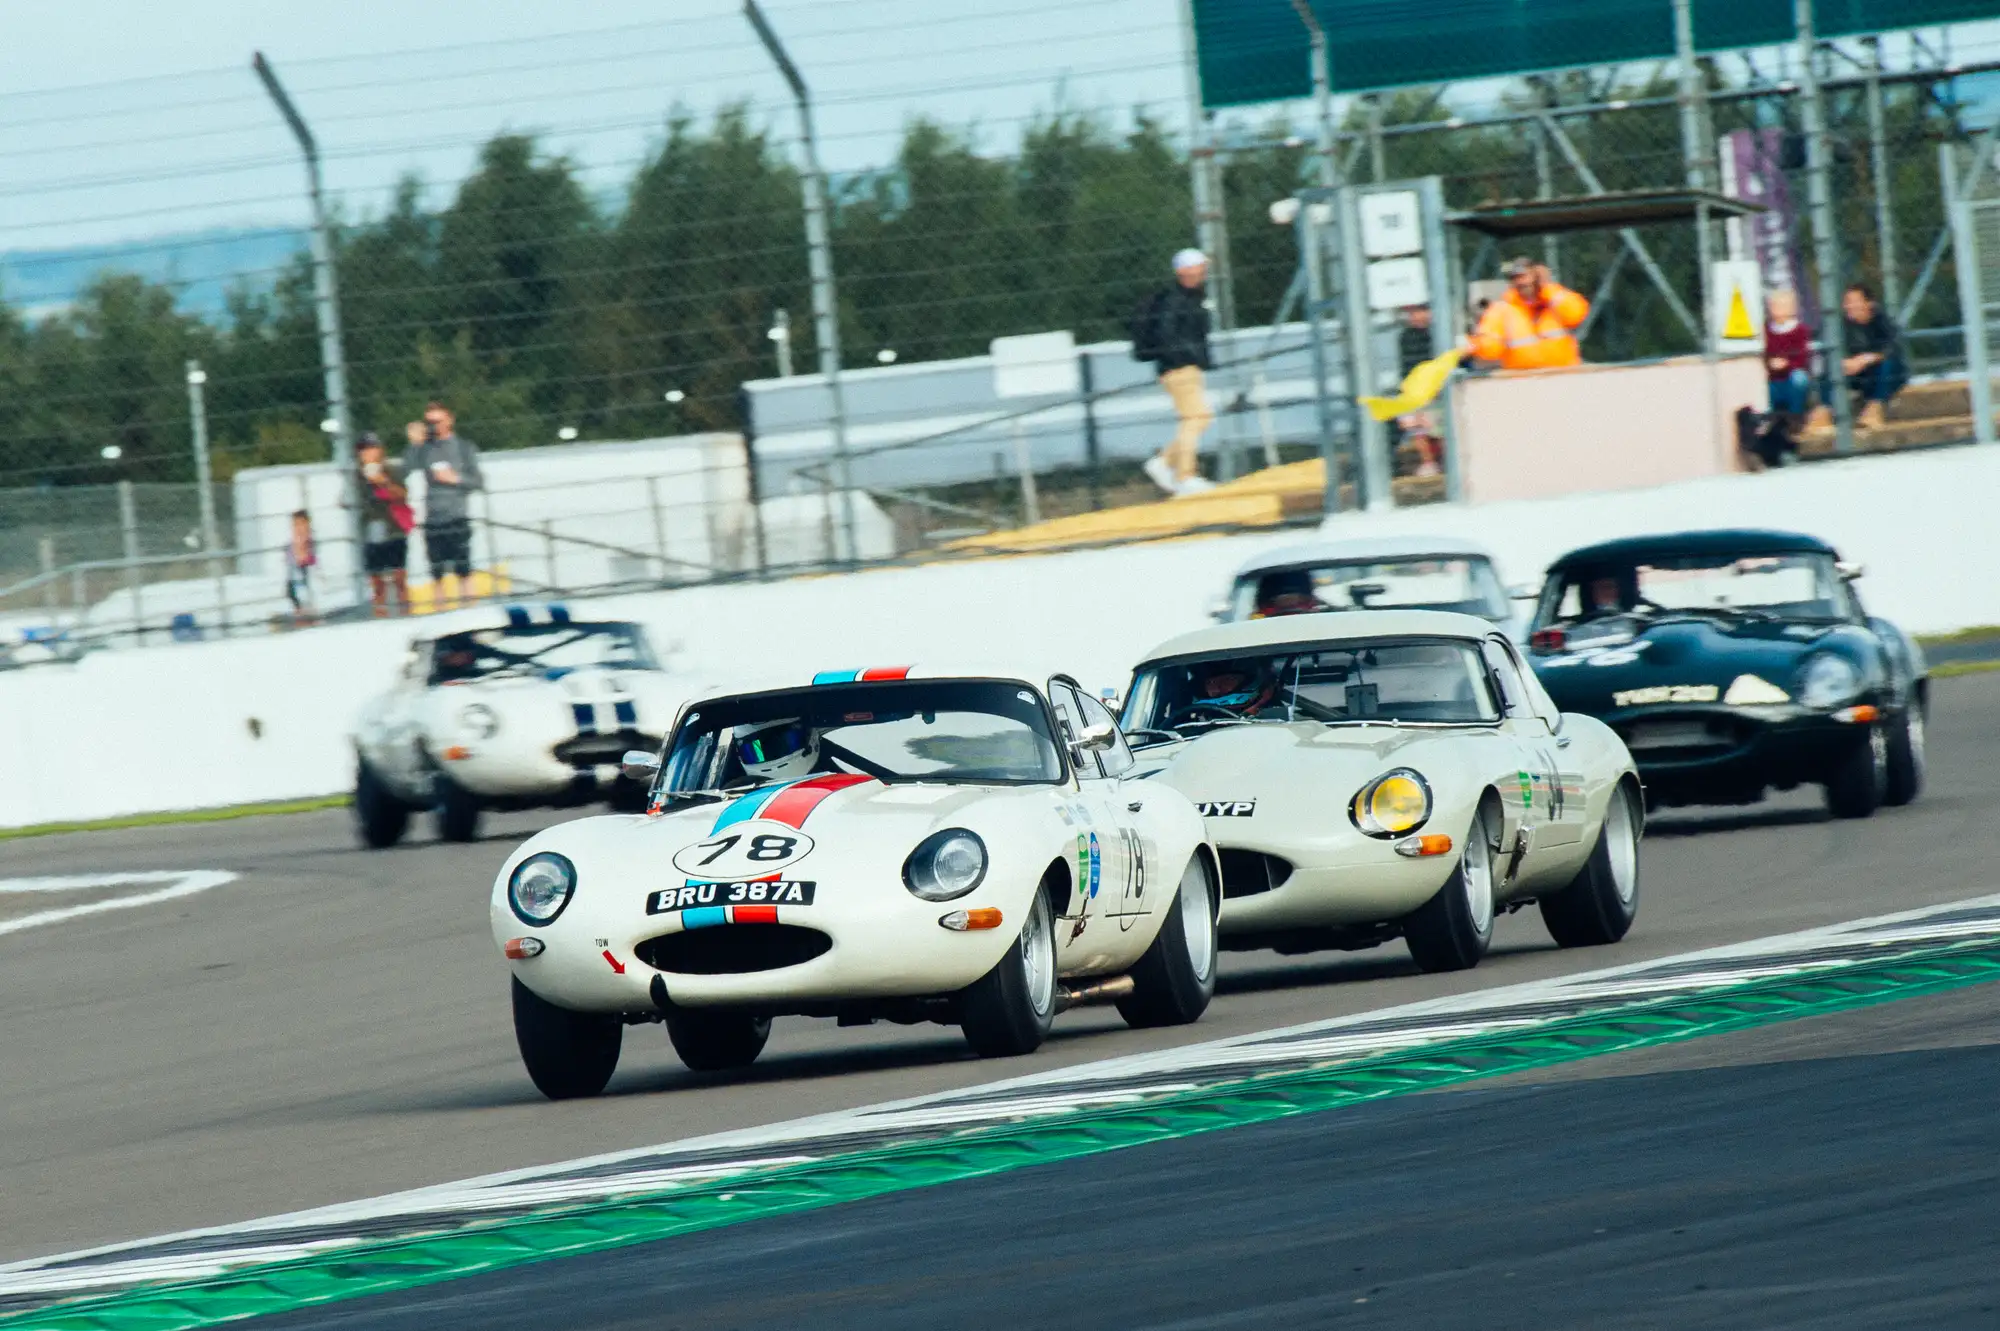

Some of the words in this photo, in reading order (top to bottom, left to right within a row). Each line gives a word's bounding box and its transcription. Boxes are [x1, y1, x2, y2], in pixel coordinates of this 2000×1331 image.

[697, 834, 798, 867] 78
[1118, 827, 1145, 899] 78
[657, 884, 717, 910] BRU
[728, 882, 803, 902] 387A
[595, 938, 609, 948] TOW
